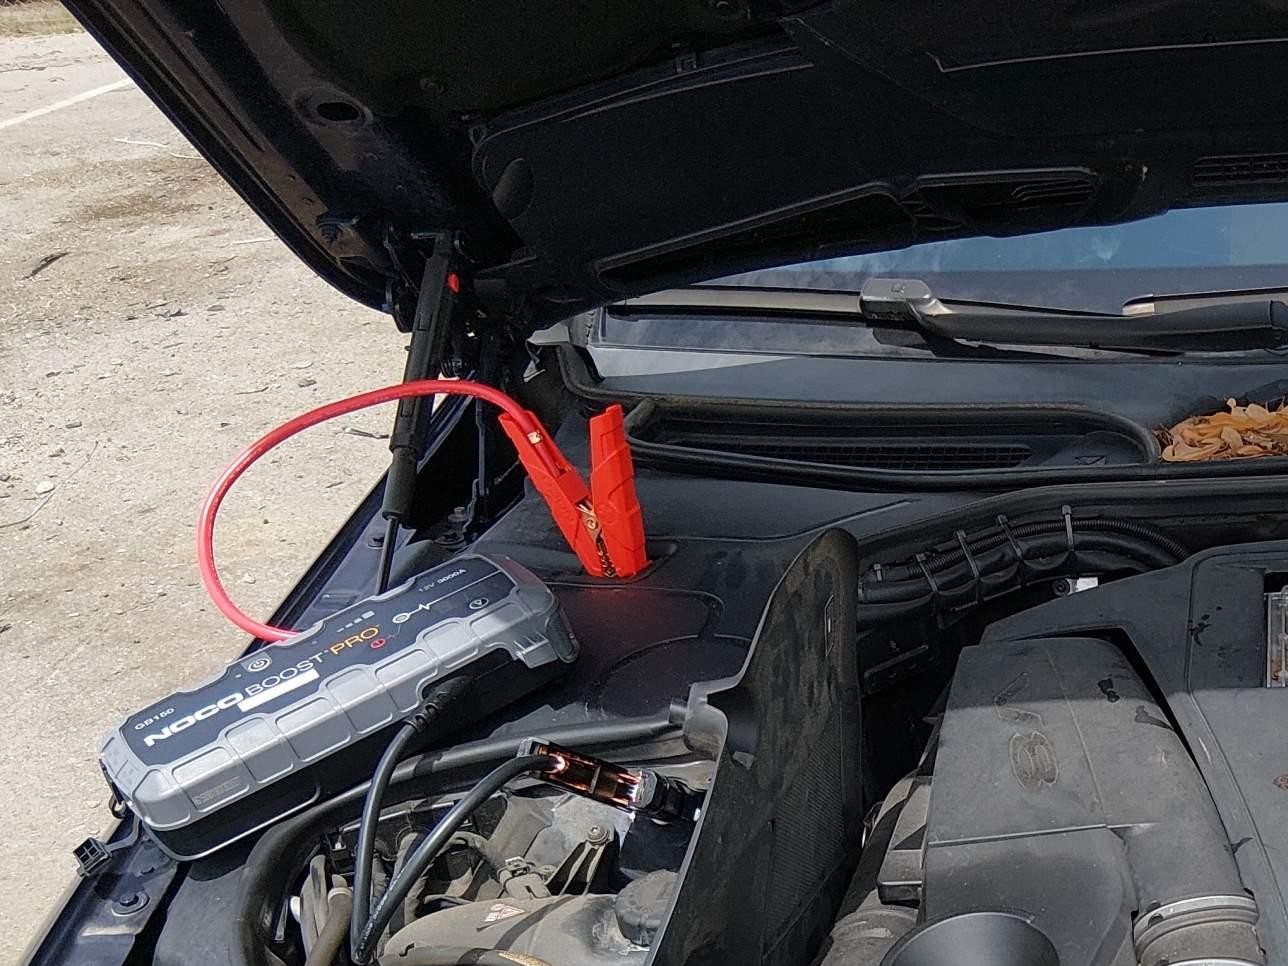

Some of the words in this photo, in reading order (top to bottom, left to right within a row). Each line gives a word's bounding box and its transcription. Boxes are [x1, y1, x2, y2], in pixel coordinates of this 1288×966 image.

[134, 707, 175, 731] GB150
[144, 692, 245, 748] NOCO
[244, 651, 324, 696] BOOST
[329, 627, 379, 655] PRO
